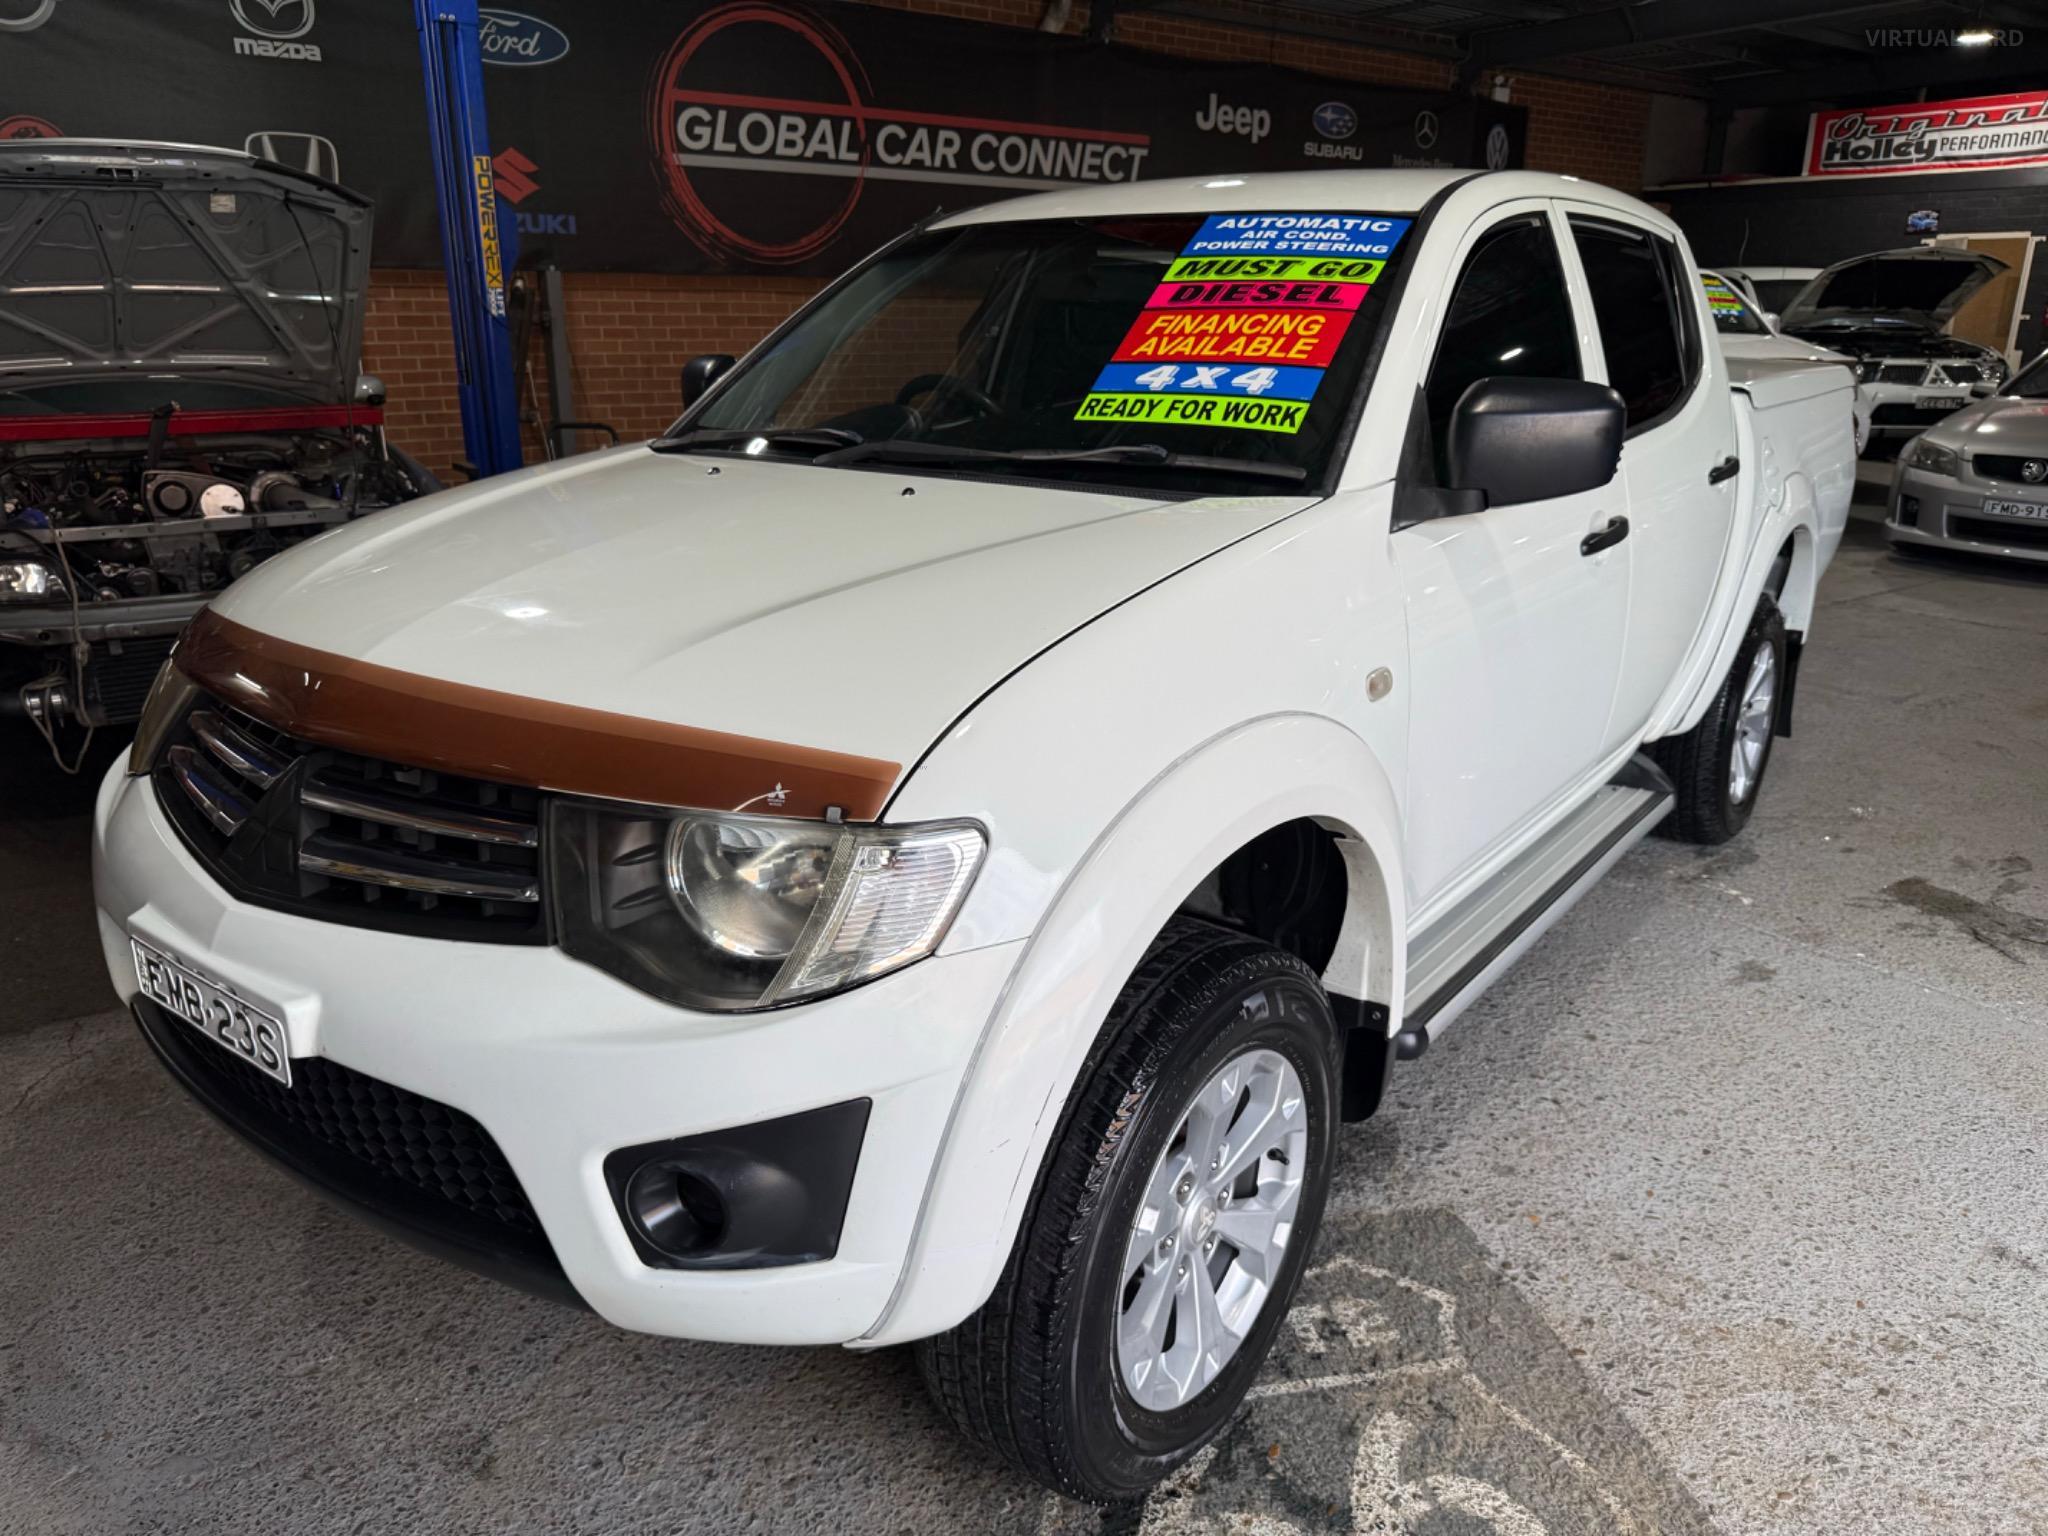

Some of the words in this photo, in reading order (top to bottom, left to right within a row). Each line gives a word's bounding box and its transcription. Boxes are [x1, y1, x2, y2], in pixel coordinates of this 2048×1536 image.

[1196, 93, 1271, 144] Jeep
[676, 107, 860, 162] GLOBAL
[875, 124, 961, 169] CAR
[970, 133, 1148, 182] CONNECT
[1304, 142, 1363, 160] SUBARU
[1824, 137, 1938, 162] Holley
[1216, 217, 1393, 232] AUTOMATIC
[1240, 230, 1277, 240] AIR
[1283, 231, 1350, 241] COND.
[1193, 241, 1269, 250] POWER
[1274, 241, 1389, 254] STEERING
[1173, 259, 1304, 278] MUST
[1307, 260, 1376, 279] GO
[1168, 283, 1344, 305] DIESEL
[1145, 313, 1327, 336] FINANCING
[1131, 336, 1320, 359] AVAILABLE
[1080, 397, 1161, 418] READY
[1164, 399, 1221, 421] FOR
[1221, 401, 1304, 428] WORK
